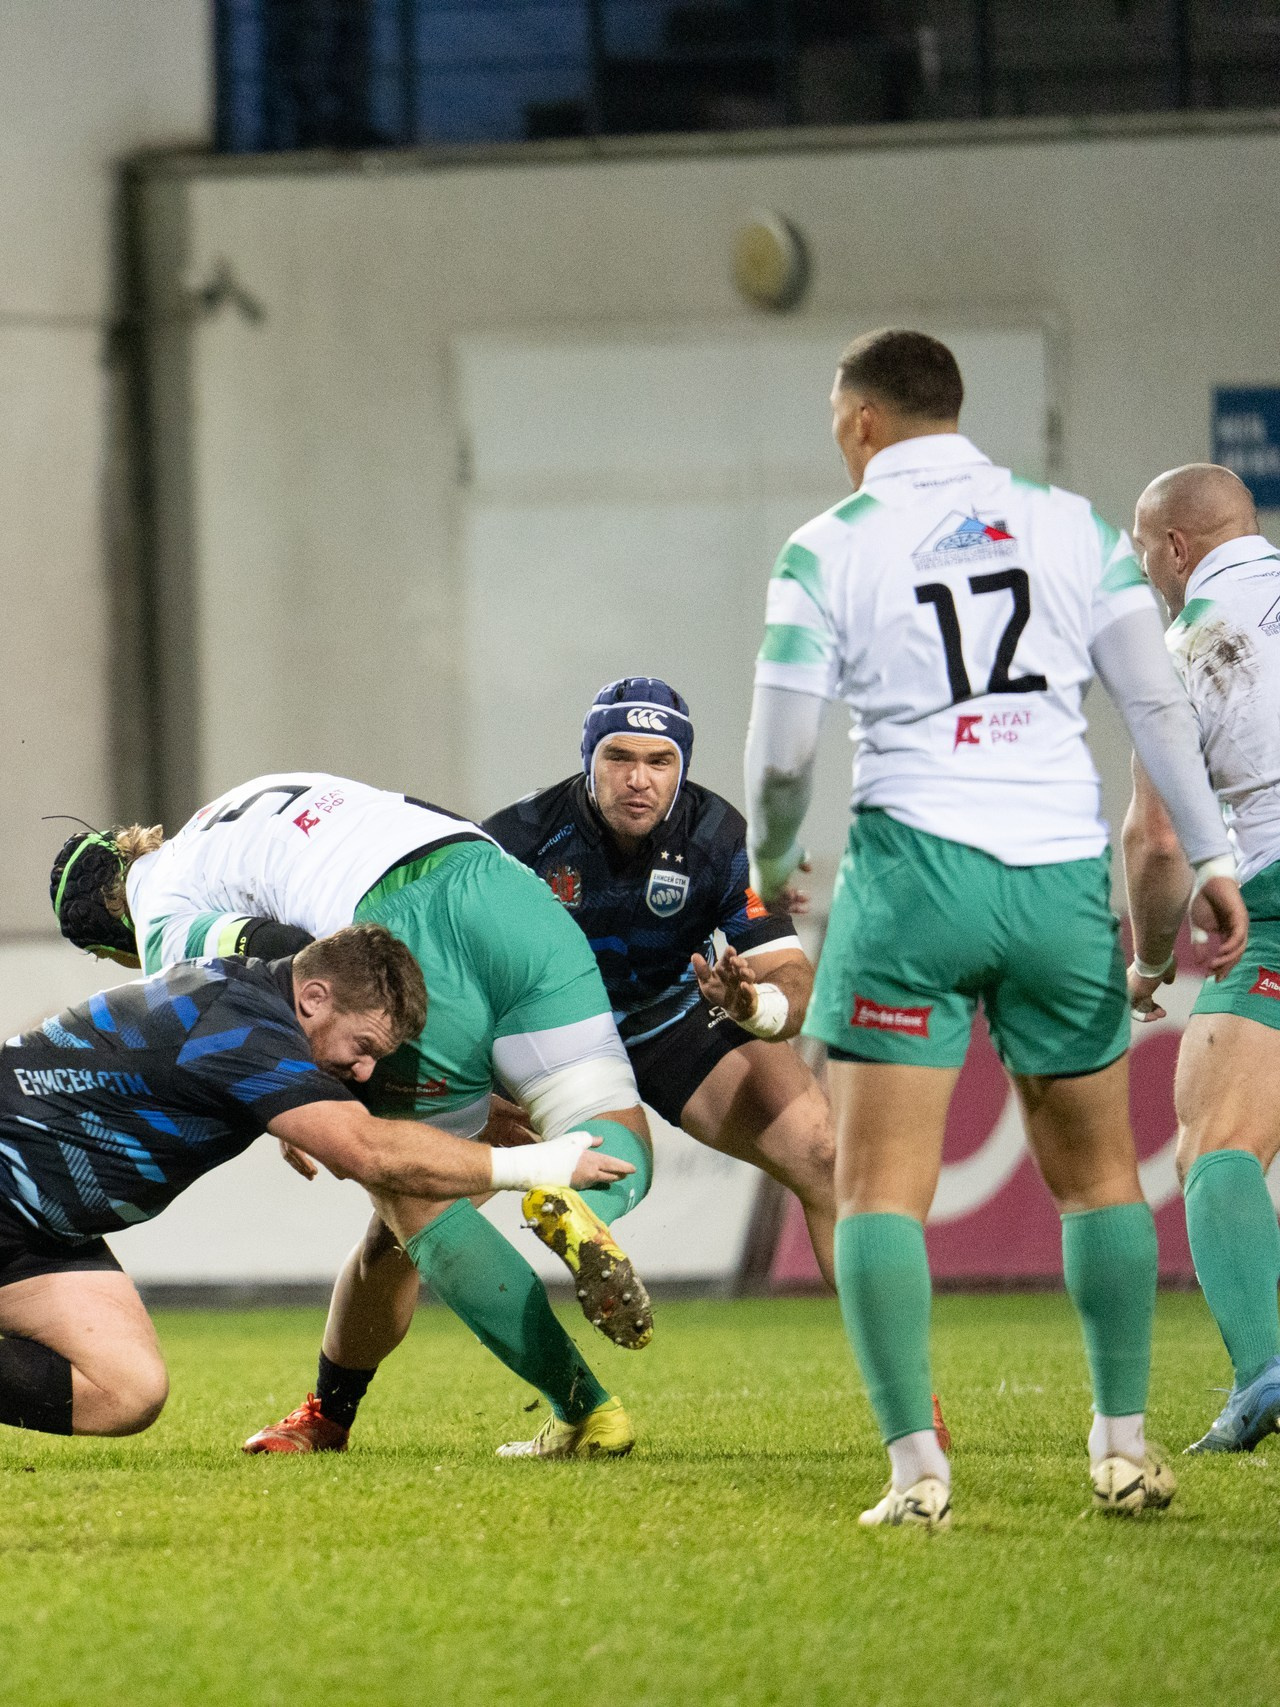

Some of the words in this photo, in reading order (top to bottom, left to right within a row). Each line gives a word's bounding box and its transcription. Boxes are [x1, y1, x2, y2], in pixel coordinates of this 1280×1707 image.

[914, 568, 1048, 705] 12
[988, 710, 1033, 727] АГАТ
[991, 729, 1019, 744] РФ
[1260, 978, 1280, 992] Аль
